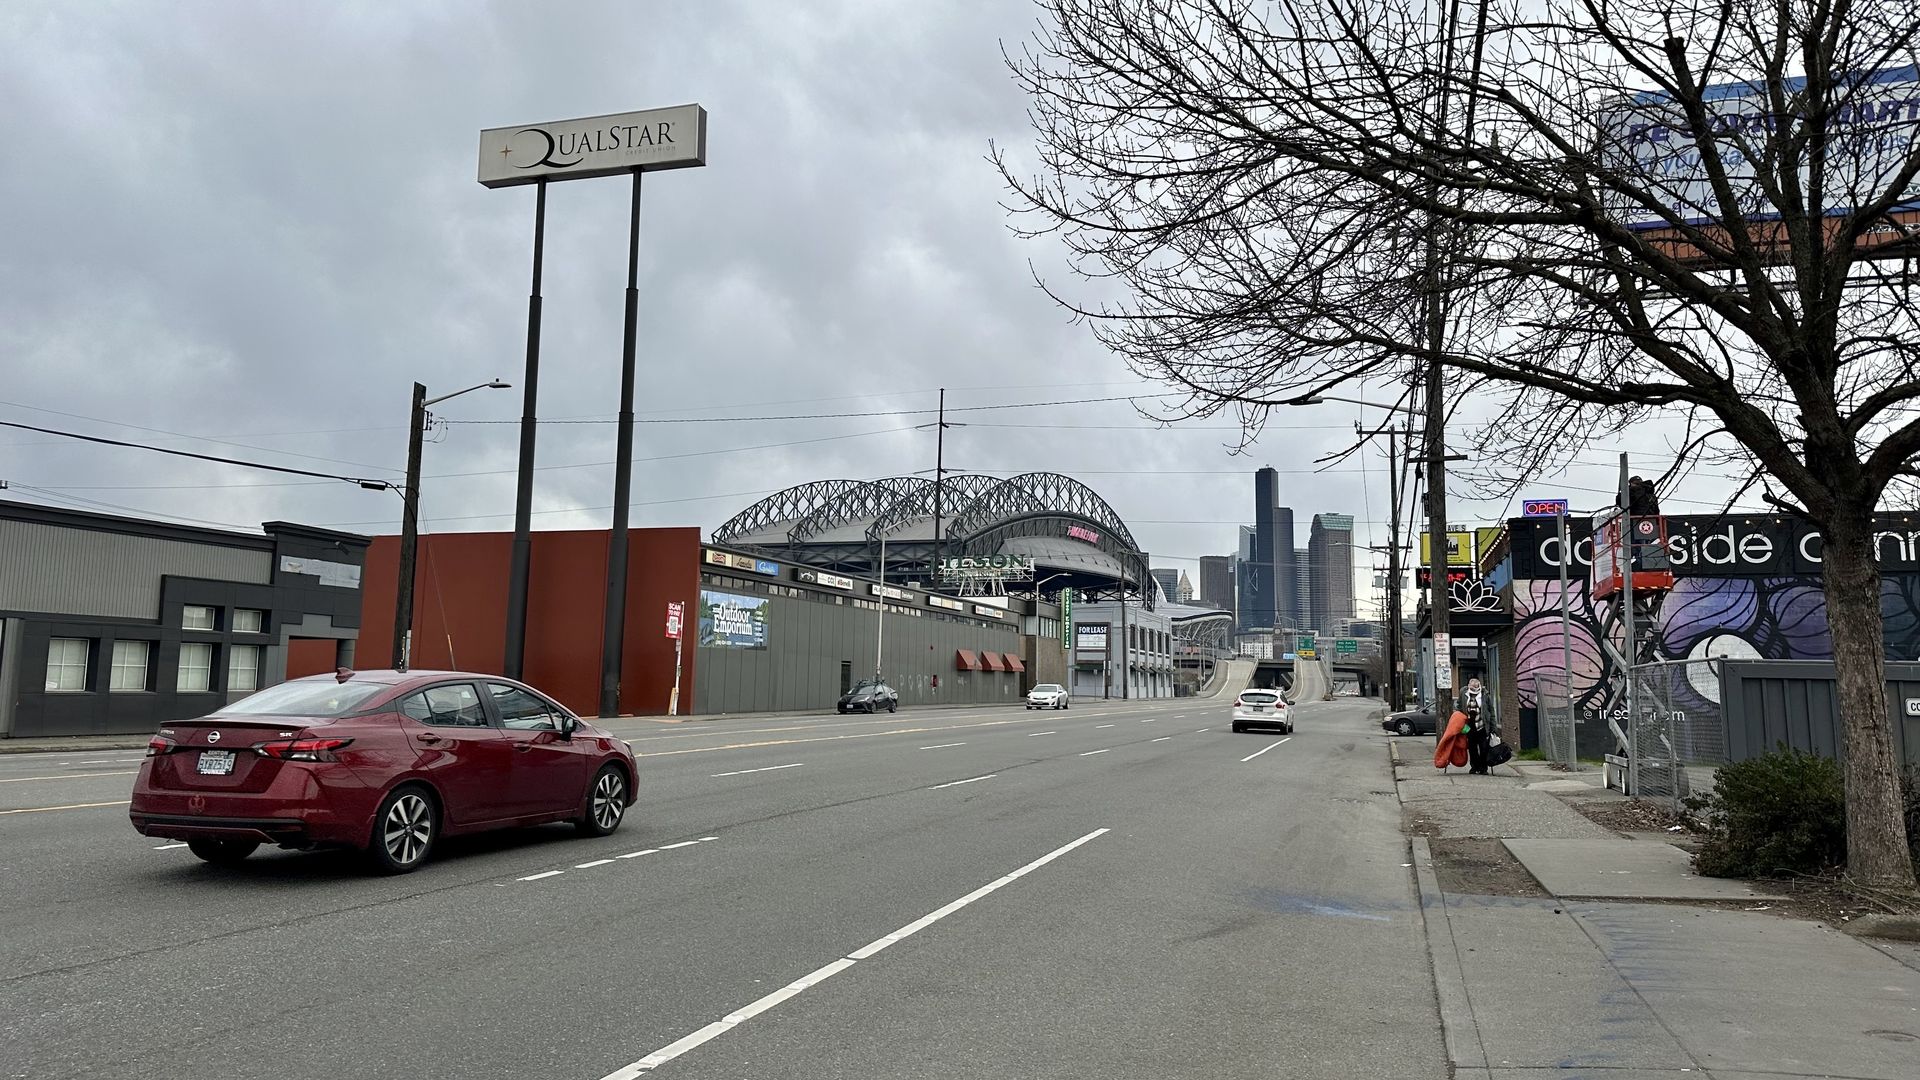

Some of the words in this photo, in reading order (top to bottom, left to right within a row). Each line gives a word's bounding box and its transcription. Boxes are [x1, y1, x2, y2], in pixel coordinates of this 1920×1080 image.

[513, 122, 675, 168] QUALSTAR
[1526, 503, 1565, 514] OPEN
[720, 602, 750, 623] Outdoor
[713, 614, 752, 636] Emporium
